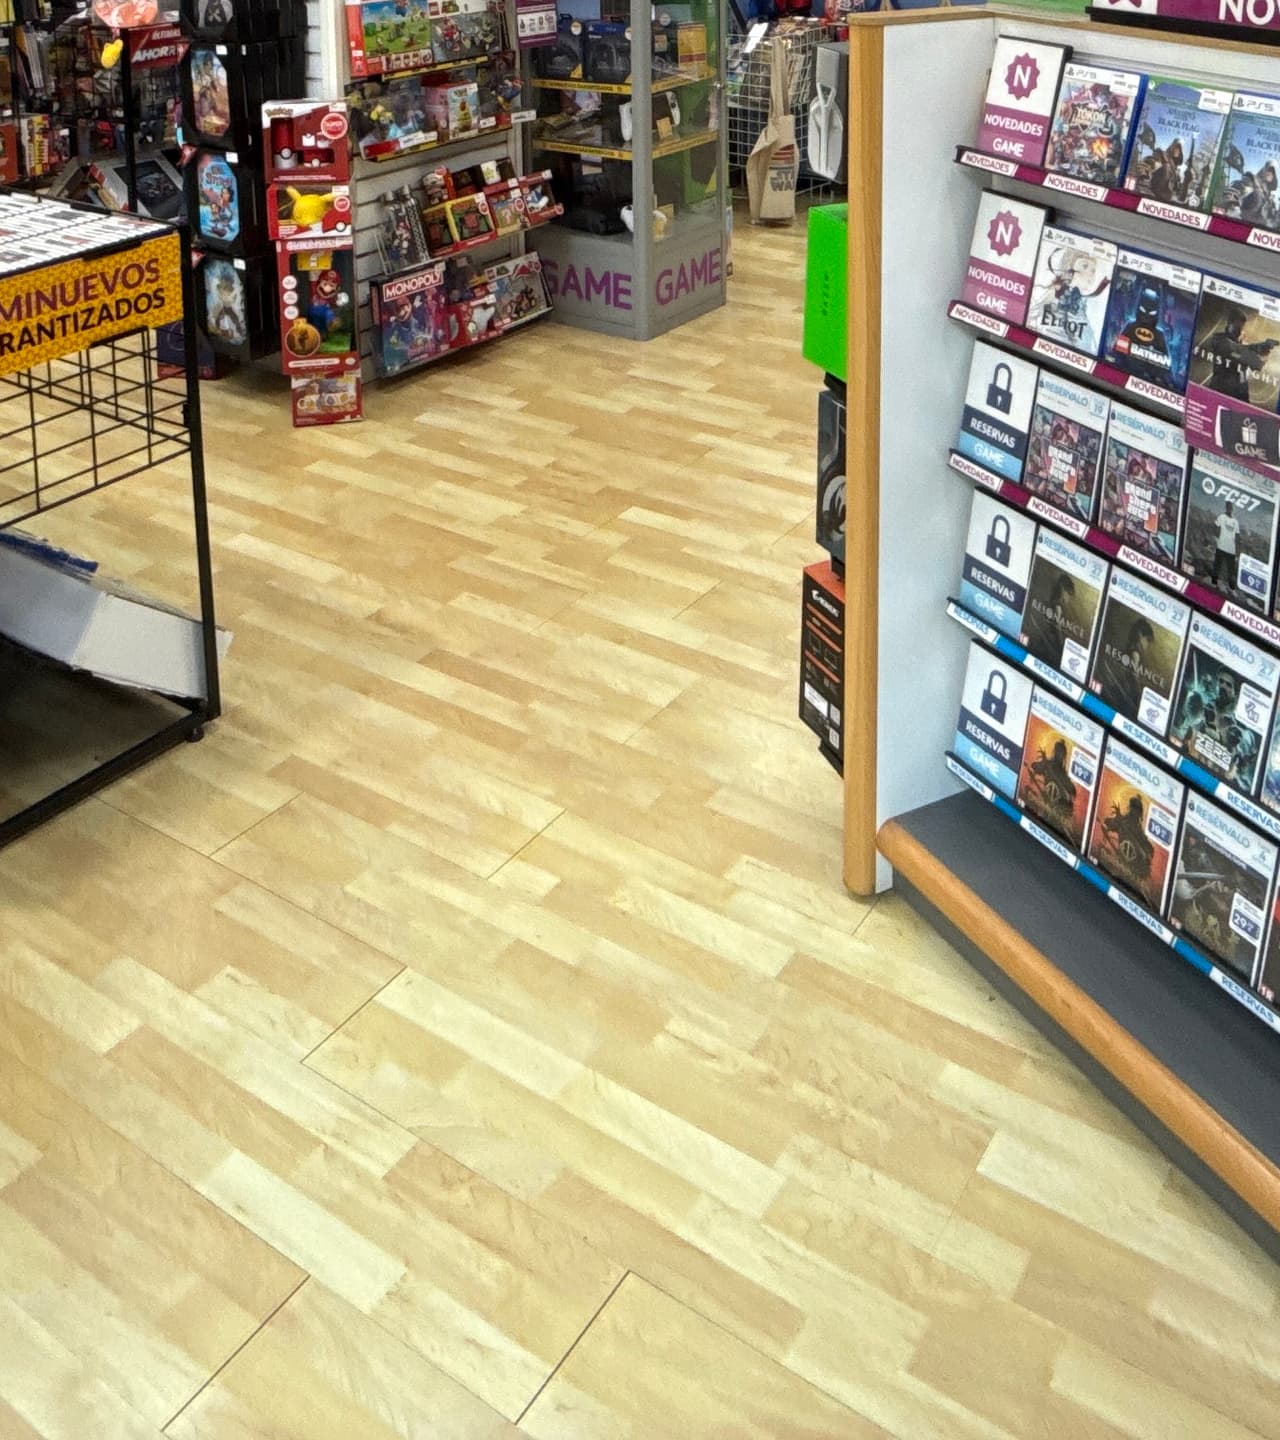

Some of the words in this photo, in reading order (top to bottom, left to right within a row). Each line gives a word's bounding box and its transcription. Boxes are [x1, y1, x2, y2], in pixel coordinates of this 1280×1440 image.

[984, 112, 1043, 138] NOVEDADES
[993, 138, 1025, 158] GAME
[965, 151, 1011, 174] NOVEDADES
[1047, 175, 1099, 199] NOVEDADES
[1141, 202, 1202, 226] NOVEDADES
[385, 271, 442, 299] MONOPOLY
[655, 260, 720, 306] GAME
[967, 264, 1025, 296] NOVEDADES
[977, 292, 1008, 314] GAME
[954, 304, 1001, 332] NOVEDADES
[1038, 339, 1088, 369] NOVEDADES
[1129, 342, 1172, 368] BATMAN
[970, 417, 1015, 448] RESERVAS
[1234, 441, 1267, 461] GAME
[1213, 485, 1261, 513] FC27
[1031, 500, 1082, 534] NOVEDADES
[1122, 548, 1179, 586] NOVEDADES
[970, 567, 1015, 602] RESERVAS
[965, 719, 1011, 760] RESERVAS
[1122, 720, 1179, 760] RESERVAS
